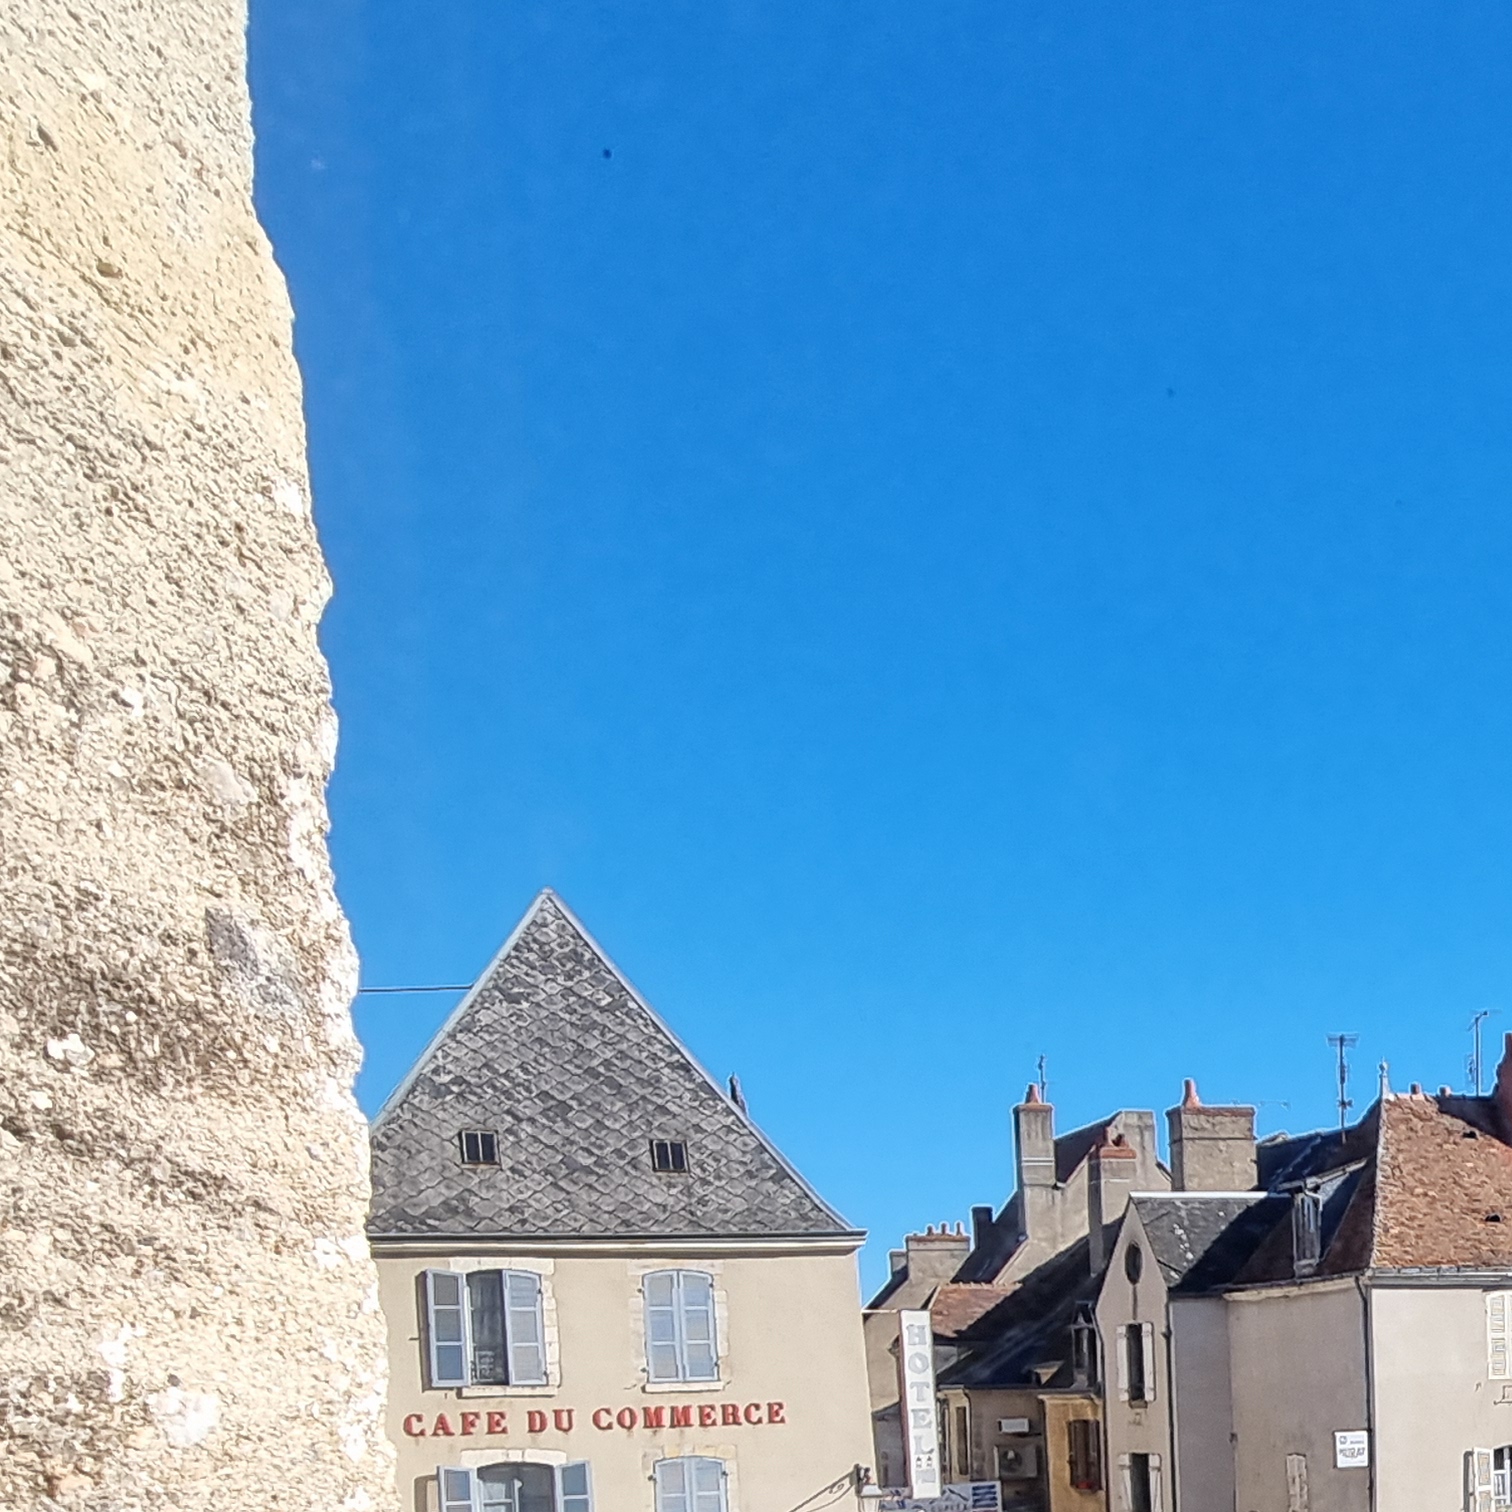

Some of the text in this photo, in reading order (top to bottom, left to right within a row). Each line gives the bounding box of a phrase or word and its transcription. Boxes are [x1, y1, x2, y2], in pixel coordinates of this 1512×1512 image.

[402, 1401, 786, 1437] CAFE DU COMMERCE
[906, 1324, 935, 1454] HOTEL
